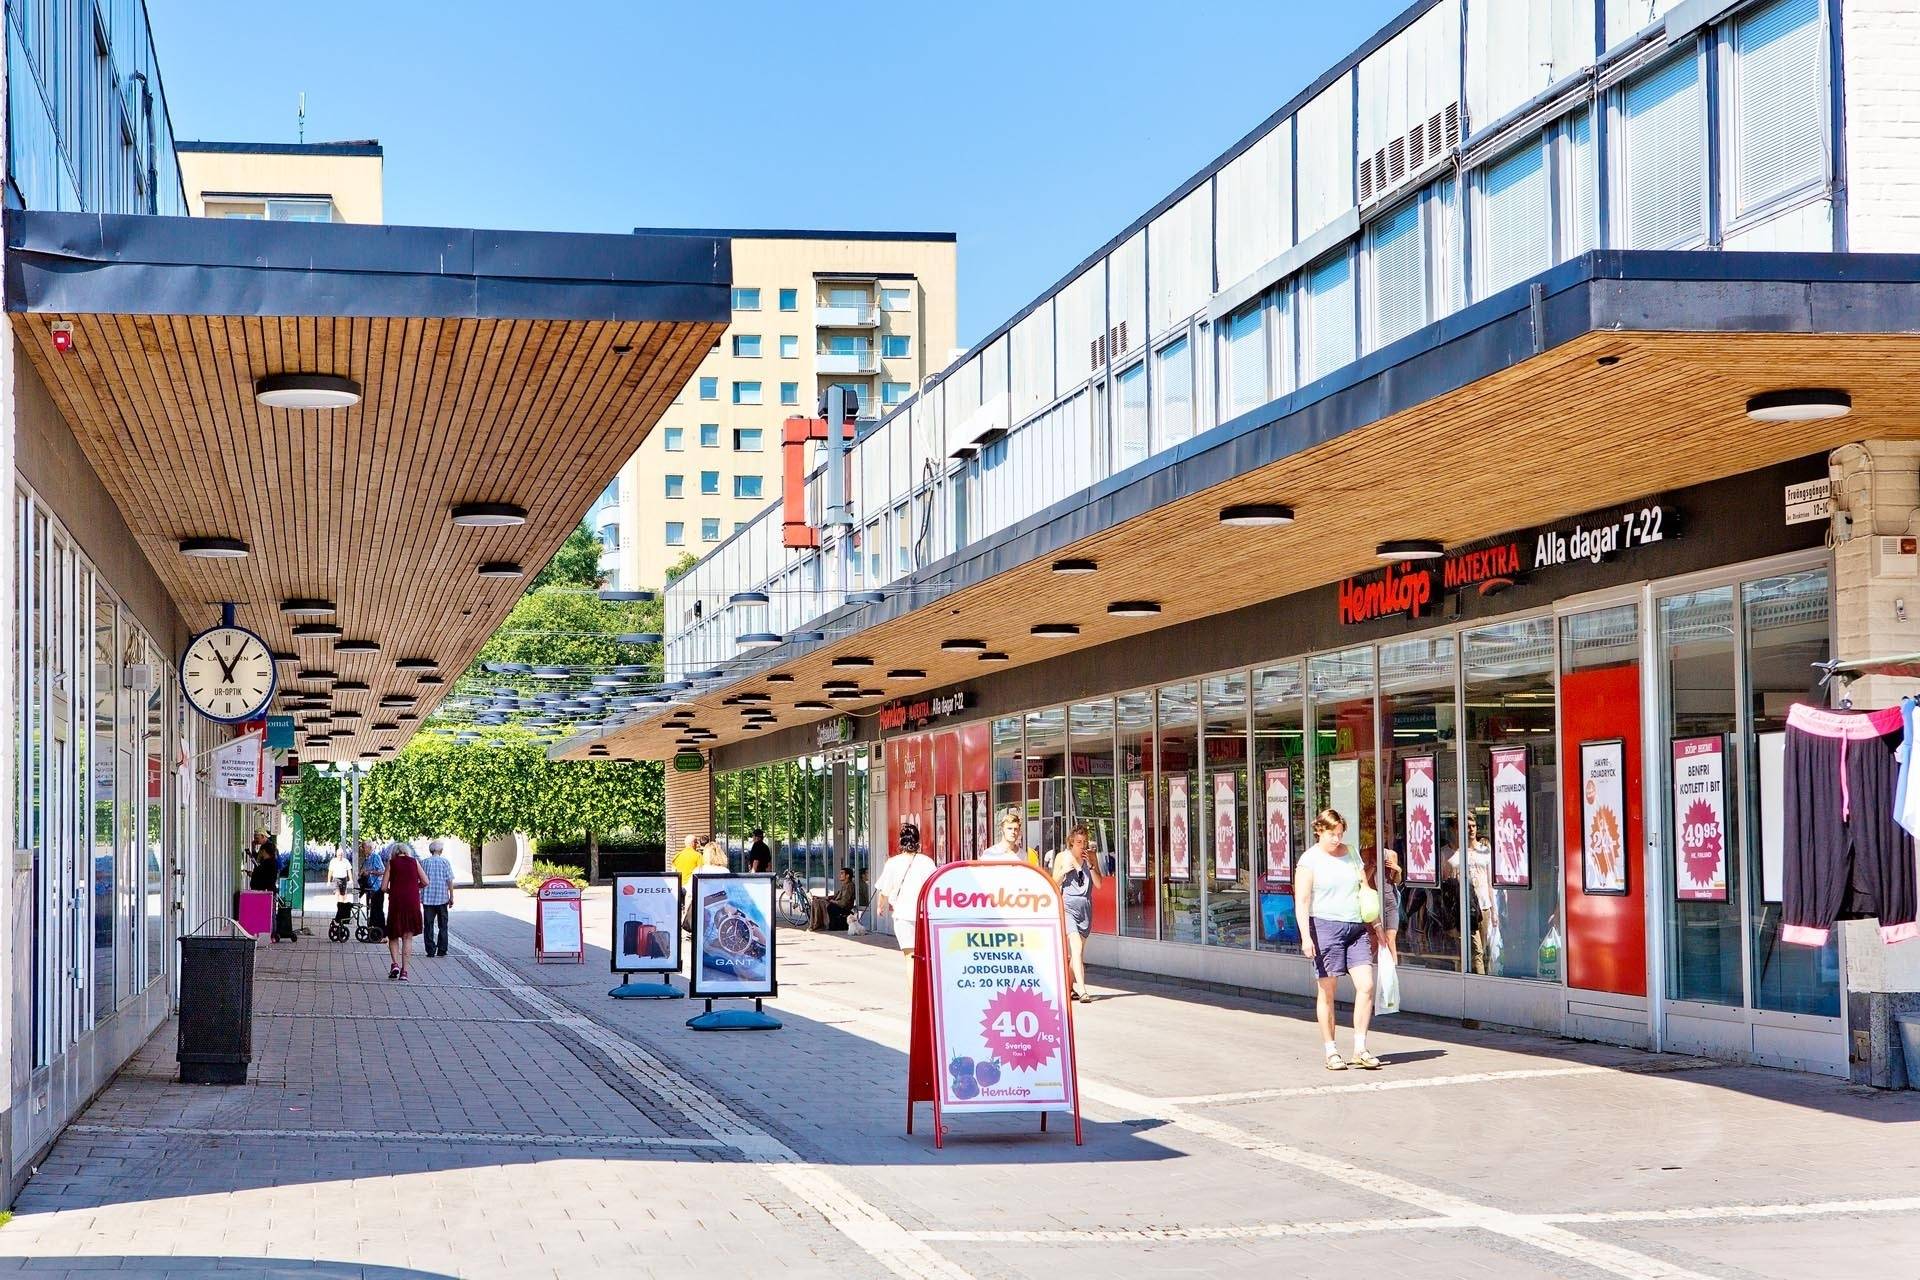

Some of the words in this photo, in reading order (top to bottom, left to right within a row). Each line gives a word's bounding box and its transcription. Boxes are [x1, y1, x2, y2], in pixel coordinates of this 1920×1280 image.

[1534, 531, 1566, 568] Alla
[1570, 524, 1619, 564] dagar
[1623, 505, 1663, 548] 7-22
[1444, 543, 1520, 588] MATEXTRA
[1338, 561, 1431, 625] Hemköp
[214, 687, 242, 696] UR-OPTIK
[1688, 764, 1710, 776] BENFRI
[1680, 780, 1705, 795] KOTLETT
[1706, 781, 1709, 791] I
[1710, 780, 1721, 793] BIT
[1409, 820, 1431, 843] 10:-
[934, 887, 1052, 912] Hemköp
[966, 932, 1025, 947] KLIPP!
[715, 958, 753, 966] GANT
[973, 952, 1023, 960] SVENSKA
[962, 965, 1034, 974] JORDGUBBAR
[957, 979, 976, 988] CA:
[980, 979, 993, 988] 20
[996, 978, 1016, 988] KR/
[1020, 979, 1041, 988] ASK
[1005, 1043, 1032, 1051] Sverige
[981, 1086, 1031, 1097] Hemköp
